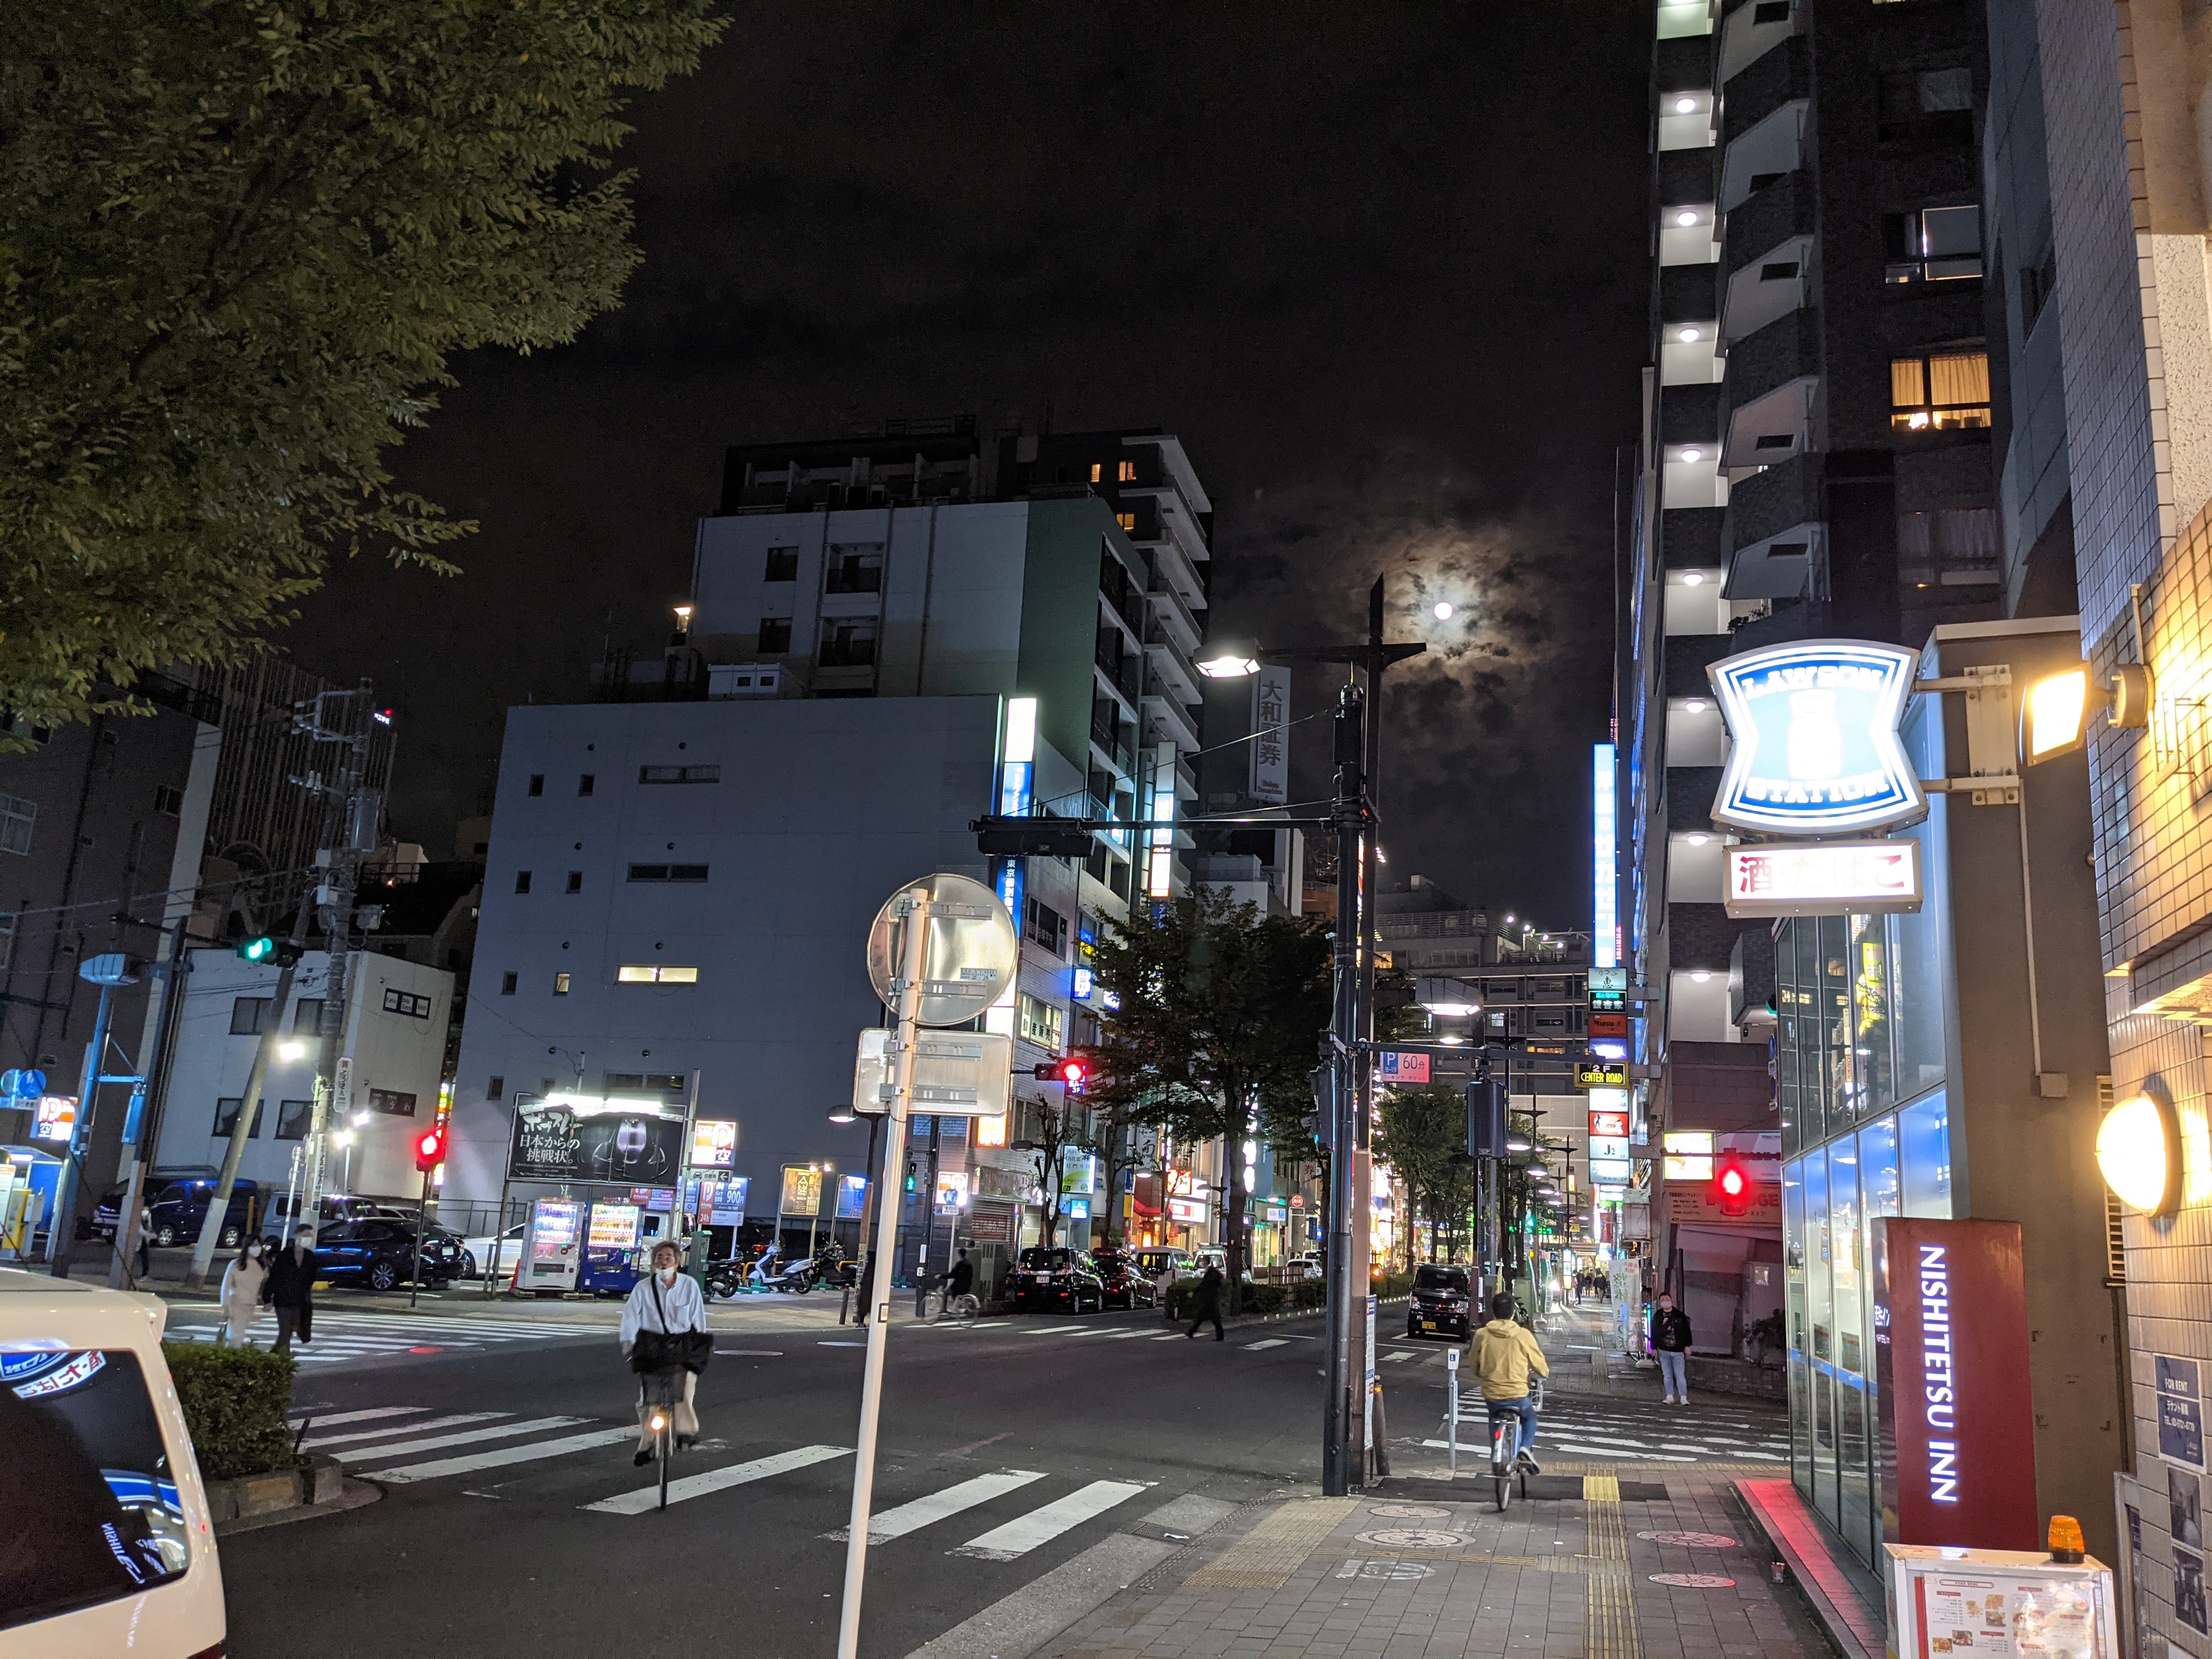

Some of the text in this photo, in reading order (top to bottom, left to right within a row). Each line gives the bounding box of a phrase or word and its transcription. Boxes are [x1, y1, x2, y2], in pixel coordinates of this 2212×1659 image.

[1741, 665, 1883, 699] LAWSON
[1259, 680, 1283, 766] 大和証券
[1746, 769, 1890, 803] STATION
[1387, 1053, 1396, 1065] P
[1403, 1055, 1425, 1070] 60分
[1581, 1072, 1623, 1084] CENTER ROAD
[38, 1122, 52, 1137] 空
[523, 1112, 583, 1135] ボブスレー
[520, 1135, 580, 1149] 日本からの
[712, 1124, 733, 1147] P
[527, 1148, 573, 1163] 挑戦状。
[715, 1148, 731, 1164] 空
[703, 1182, 714, 1201] P
[726, 1190, 744, 1204] 900円
[1920, 1246, 1957, 1502] NISHITETSU INN
[2165, 1378, 2188, 1392] FOR RENT
